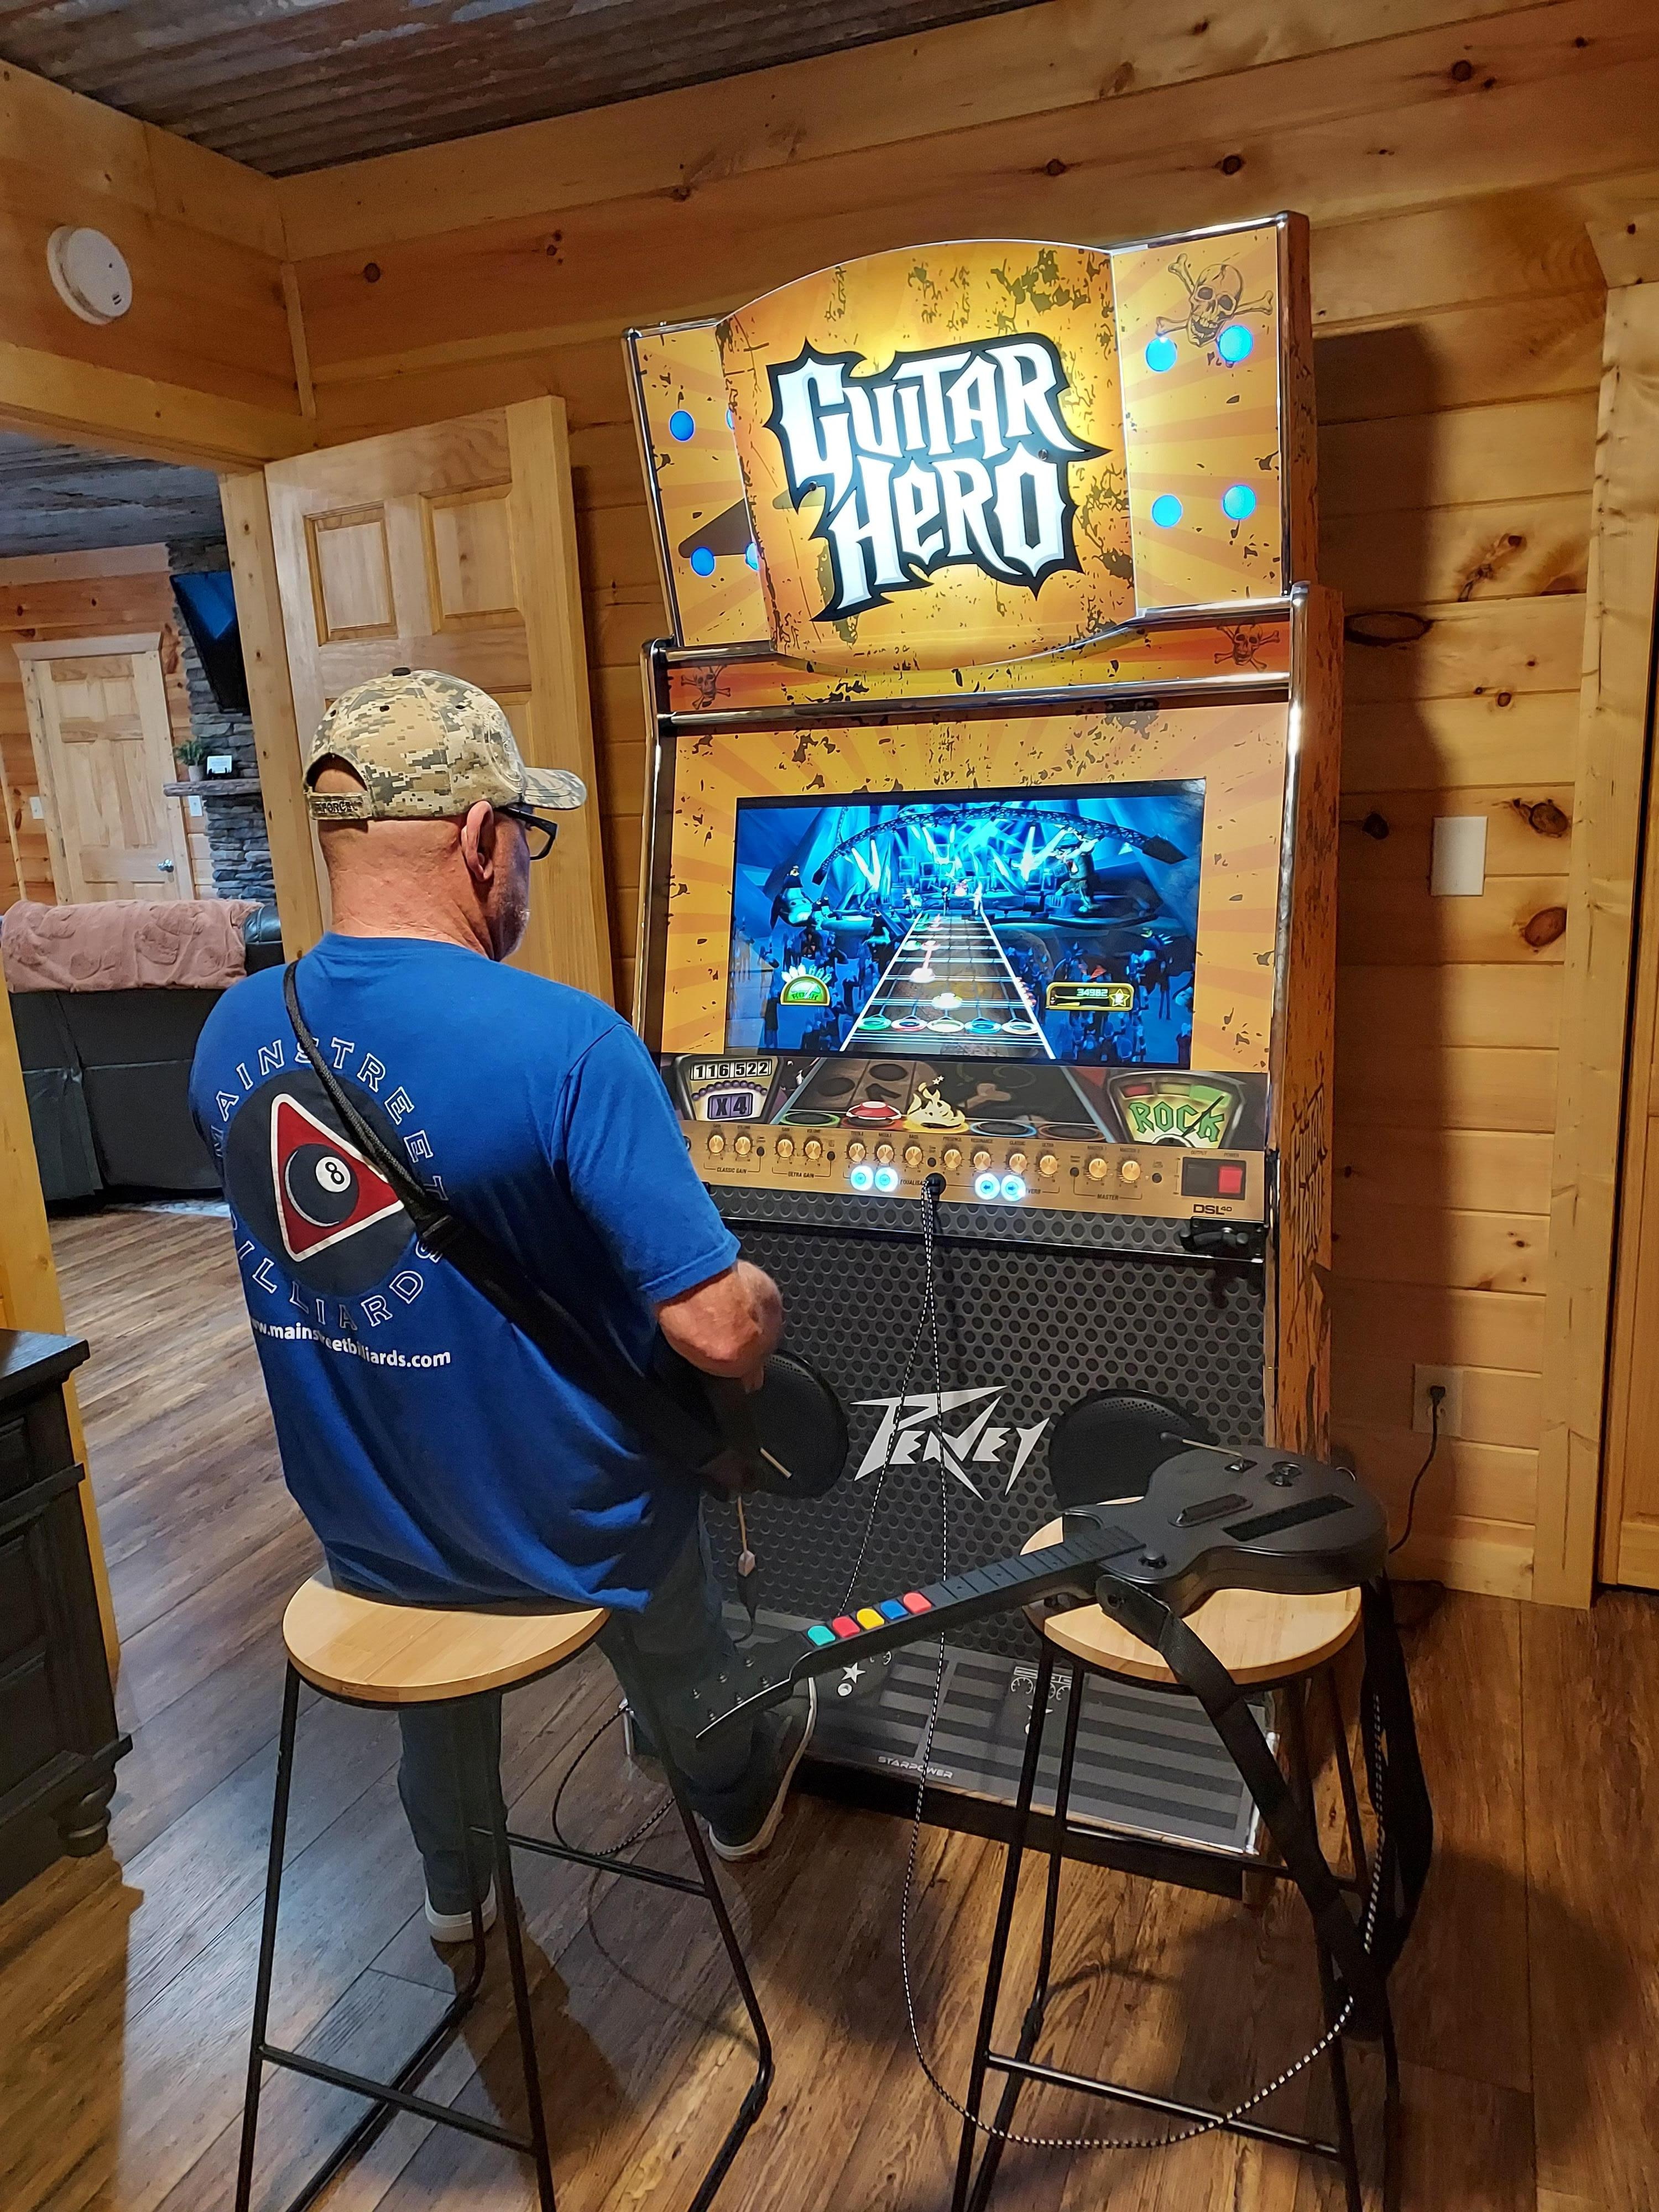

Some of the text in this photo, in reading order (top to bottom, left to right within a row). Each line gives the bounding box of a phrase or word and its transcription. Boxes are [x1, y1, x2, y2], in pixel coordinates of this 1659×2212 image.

[791, 992, 818, 1000] ROK
[696, 1062, 768, 1078] 116522
[1128, 1101, 1225, 1142] ROCK
[325, 1162, 345, 1185] 8
[849, 1385, 1050, 1501] PEAVEY
[878, 1756, 953, 1779] STARPOWER
